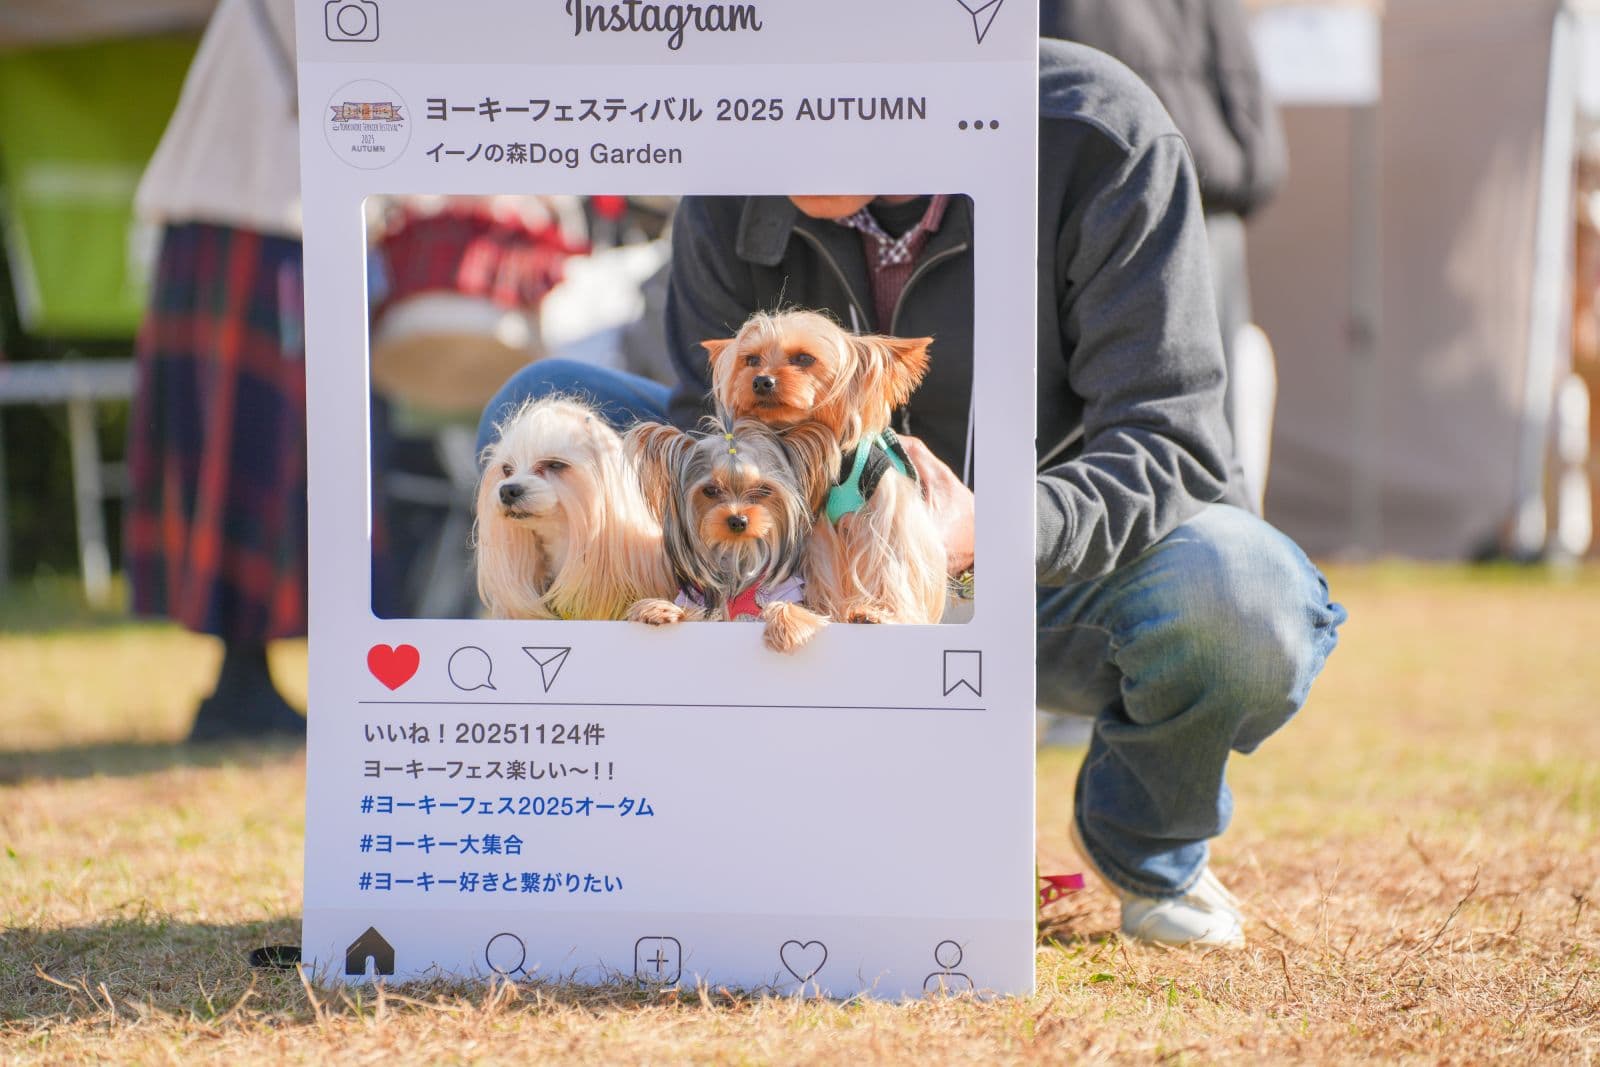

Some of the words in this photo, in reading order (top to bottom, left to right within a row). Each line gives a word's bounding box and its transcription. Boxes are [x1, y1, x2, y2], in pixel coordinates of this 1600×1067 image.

[565, 0, 763, 51] Instagram
[425, 96, 704, 123] ヨーキーフェスティバル
[716, 98, 784, 121] 2025
[795, 96, 927, 121] AUTUMN
[351, 144, 386, 153] AUTUMN
[425, 141, 580, 169] イーノの森Dog
[589, 142, 683, 165] Garden
[360, 794, 655, 818] #ヨーキーフェス2025オータム
[359, 833, 525, 856] #ヨーキー大集合
[358, 871, 624, 894] #ヨーキー好きと繋がりたい
